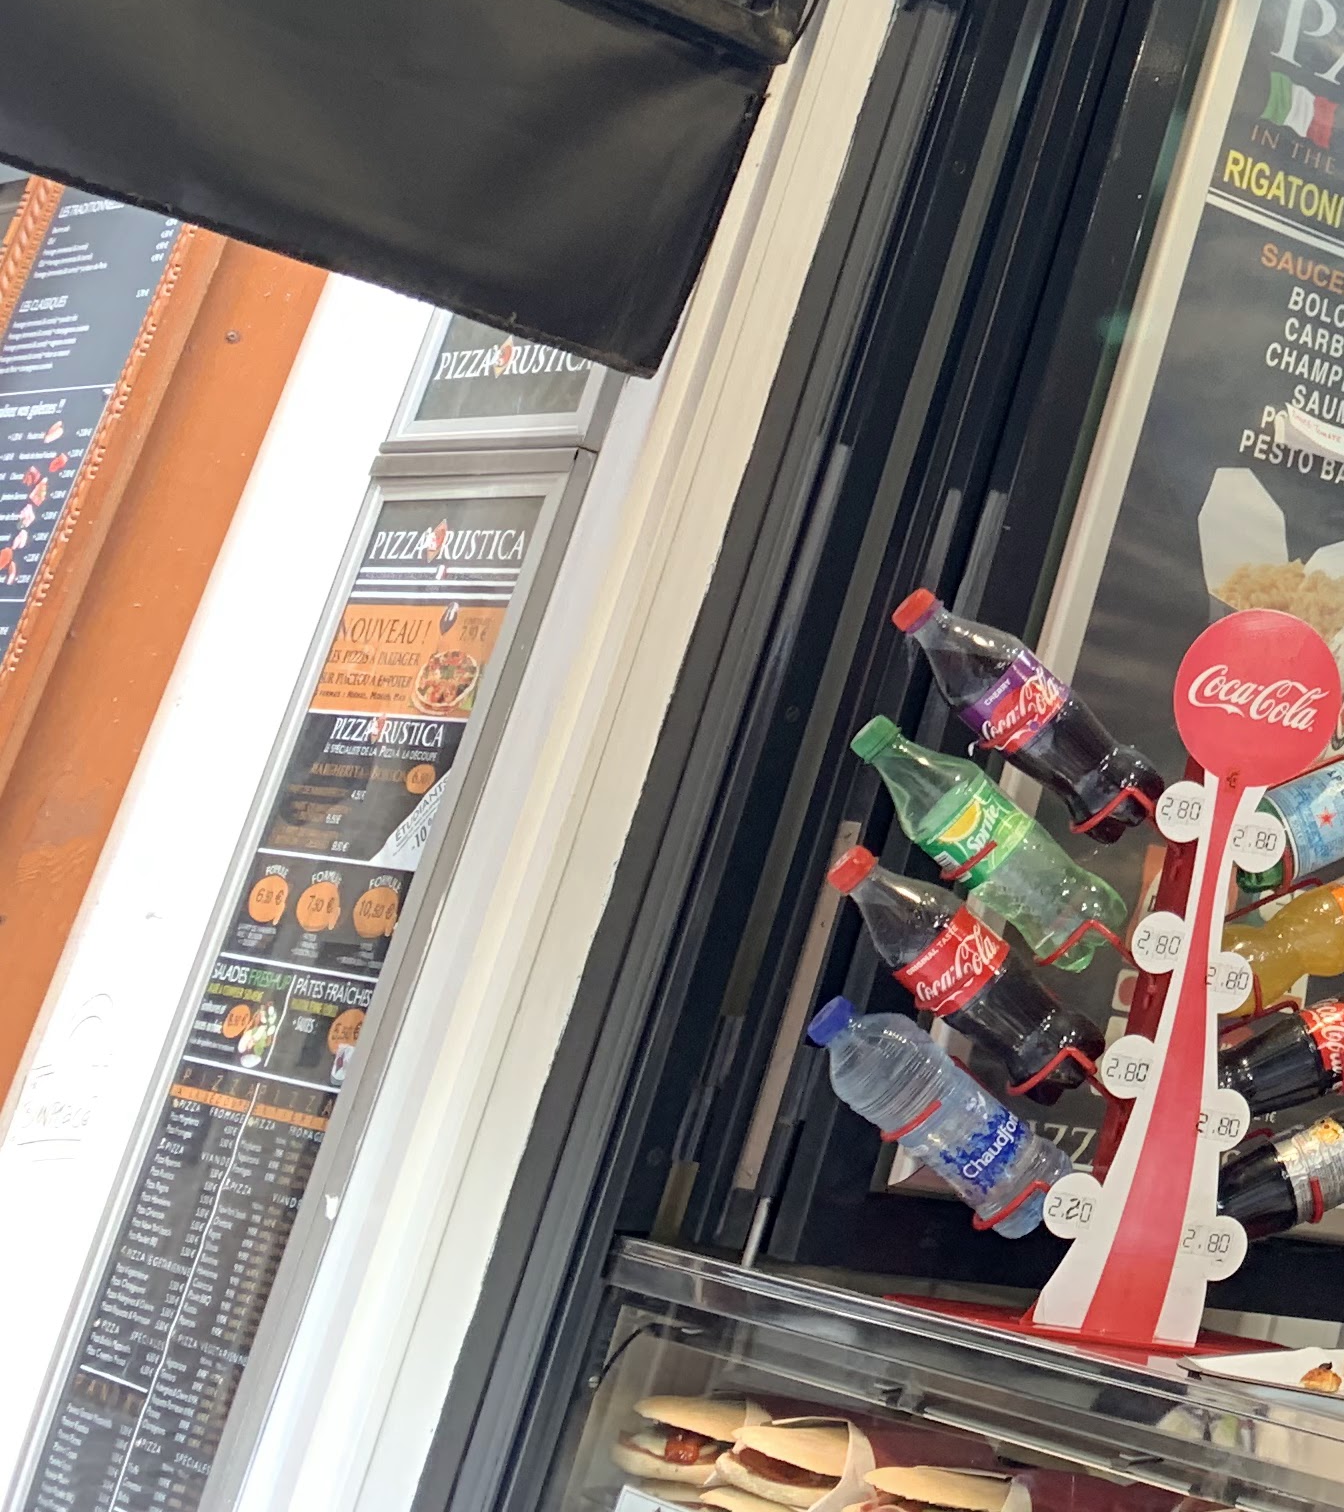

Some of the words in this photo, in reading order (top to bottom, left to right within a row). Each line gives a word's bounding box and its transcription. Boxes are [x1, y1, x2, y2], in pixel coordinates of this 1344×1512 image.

[1251, 125, 1279, 149] IN
[1290, 145, 1336, 176] THE
[434, 348, 490, 380] PIZZA
[1239, 429, 1314, 474] PESTO
[369, 530, 424, 560] PIZZA
[437, 529, 526, 560] RUSTICA
[984, 677, 1012, 707] CHERRY
[1188, 664, 1329, 733] Coca-Cola
[330, 716, 370, 743] PIZZA
[379, 719, 445, 748] RUSTICA
[905, 947, 940, 977] ORIGINAL
[936, 924, 959, 950] TASTE
[916, 925, 1000, 1002] Coca-Cola
[272, 1193, 302, 1210] VIAND
